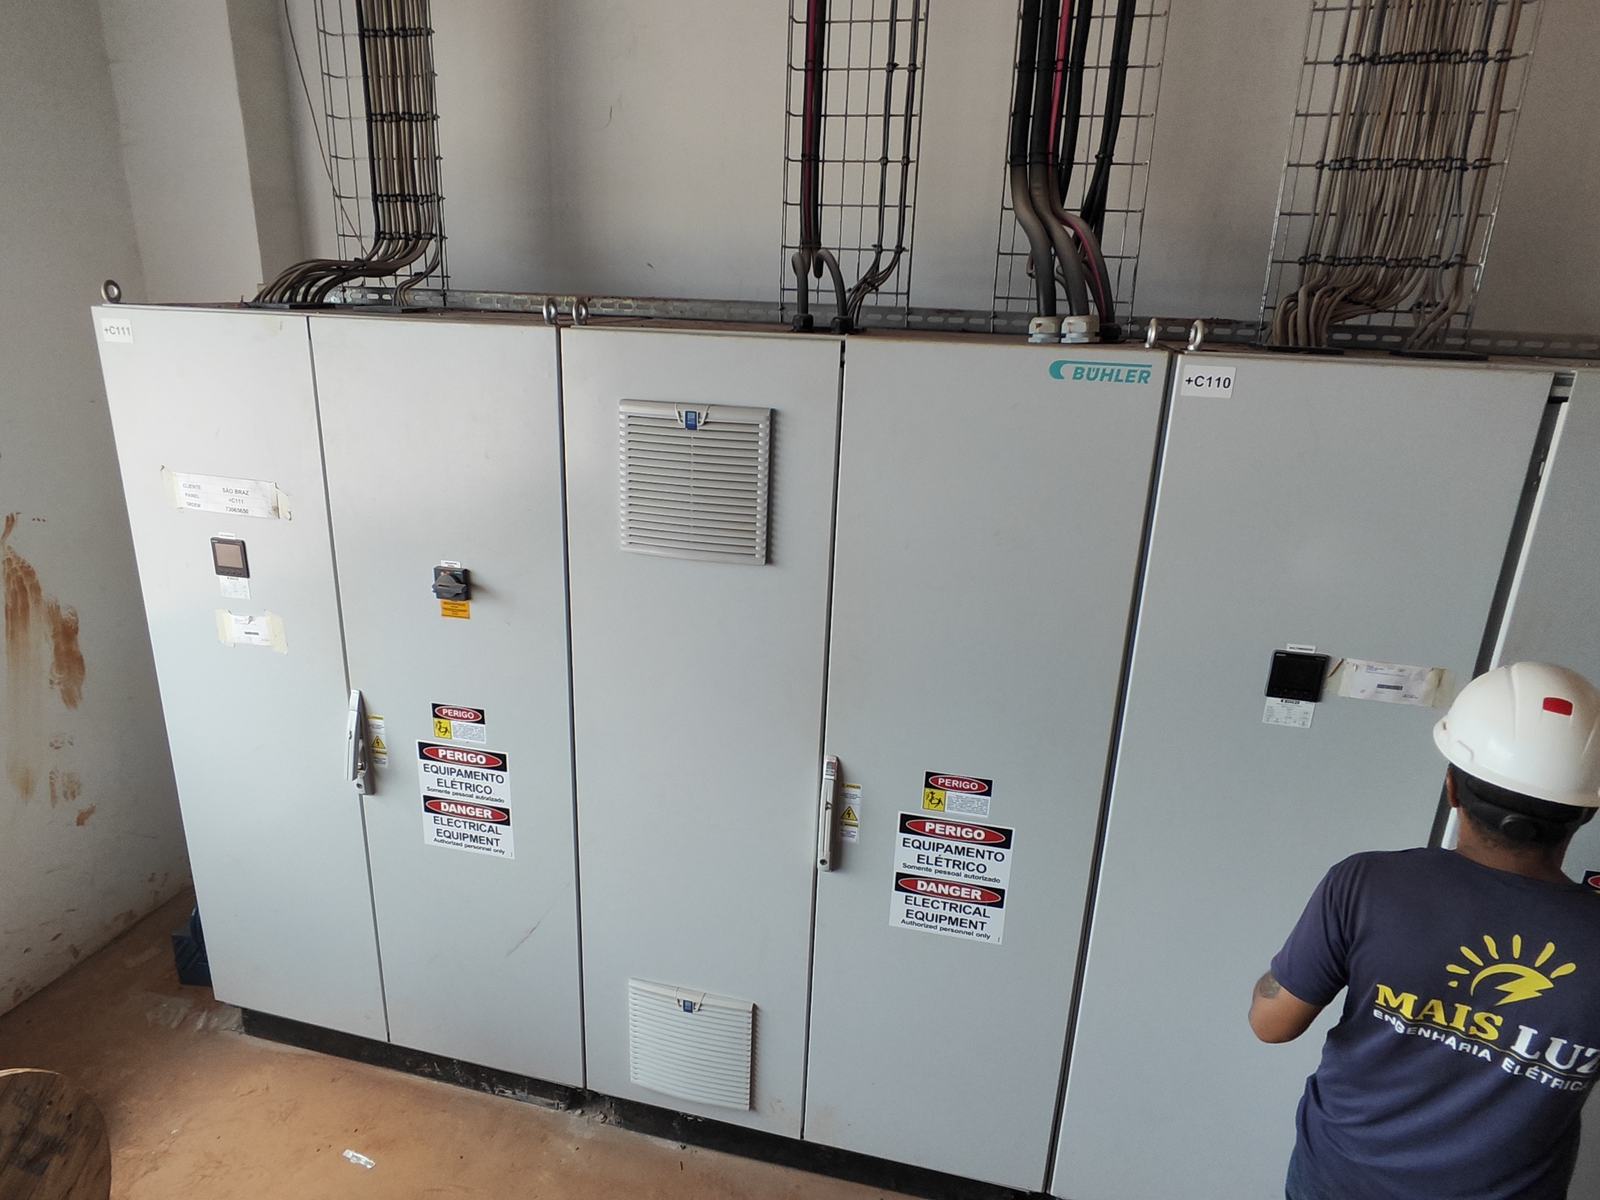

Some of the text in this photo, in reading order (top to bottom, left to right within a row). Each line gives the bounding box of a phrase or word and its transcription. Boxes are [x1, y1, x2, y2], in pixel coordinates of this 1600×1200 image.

[104, 325, 131, 336] +C111
[1072, 366, 1151, 384] BÜHLER
[1185, 375, 1231, 389] +C110
[442, 708, 475, 719] PERIGO
[438, 749, 486, 764] PERIGO
[423, 764, 504, 784] EQUIPAMENTO
[938, 777, 978, 790] PERIGO
[426, 786, 451, 795] Somente
[437, 778, 493, 795] ELÉTRICO
[440, 802, 493, 819] DANGER
[433, 816, 502, 835] ELECTRICAL
[925, 822, 985, 840] PERIGO
[433, 838, 463, 847] Authorized
[464, 842, 491, 852] personnel
[436, 828, 500, 847] EQUIPMENT
[902, 837, 1005, 862] EQUIPAMENTO
[902, 862, 1001, 884] Somente pessoal autorizado
[916, 854, 987, 874] ELÉTRICO
[917, 880, 982, 900] DANGER
[904, 895, 991, 919] ELECTRICAL
[900, 918, 991, 940] Authorized personnel only
[905, 908, 987, 931] EQUIPMENT
[1375, 984, 1503, 1041] MAIS
[1372, 1008, 1492, 1062] ENGENHARIA
